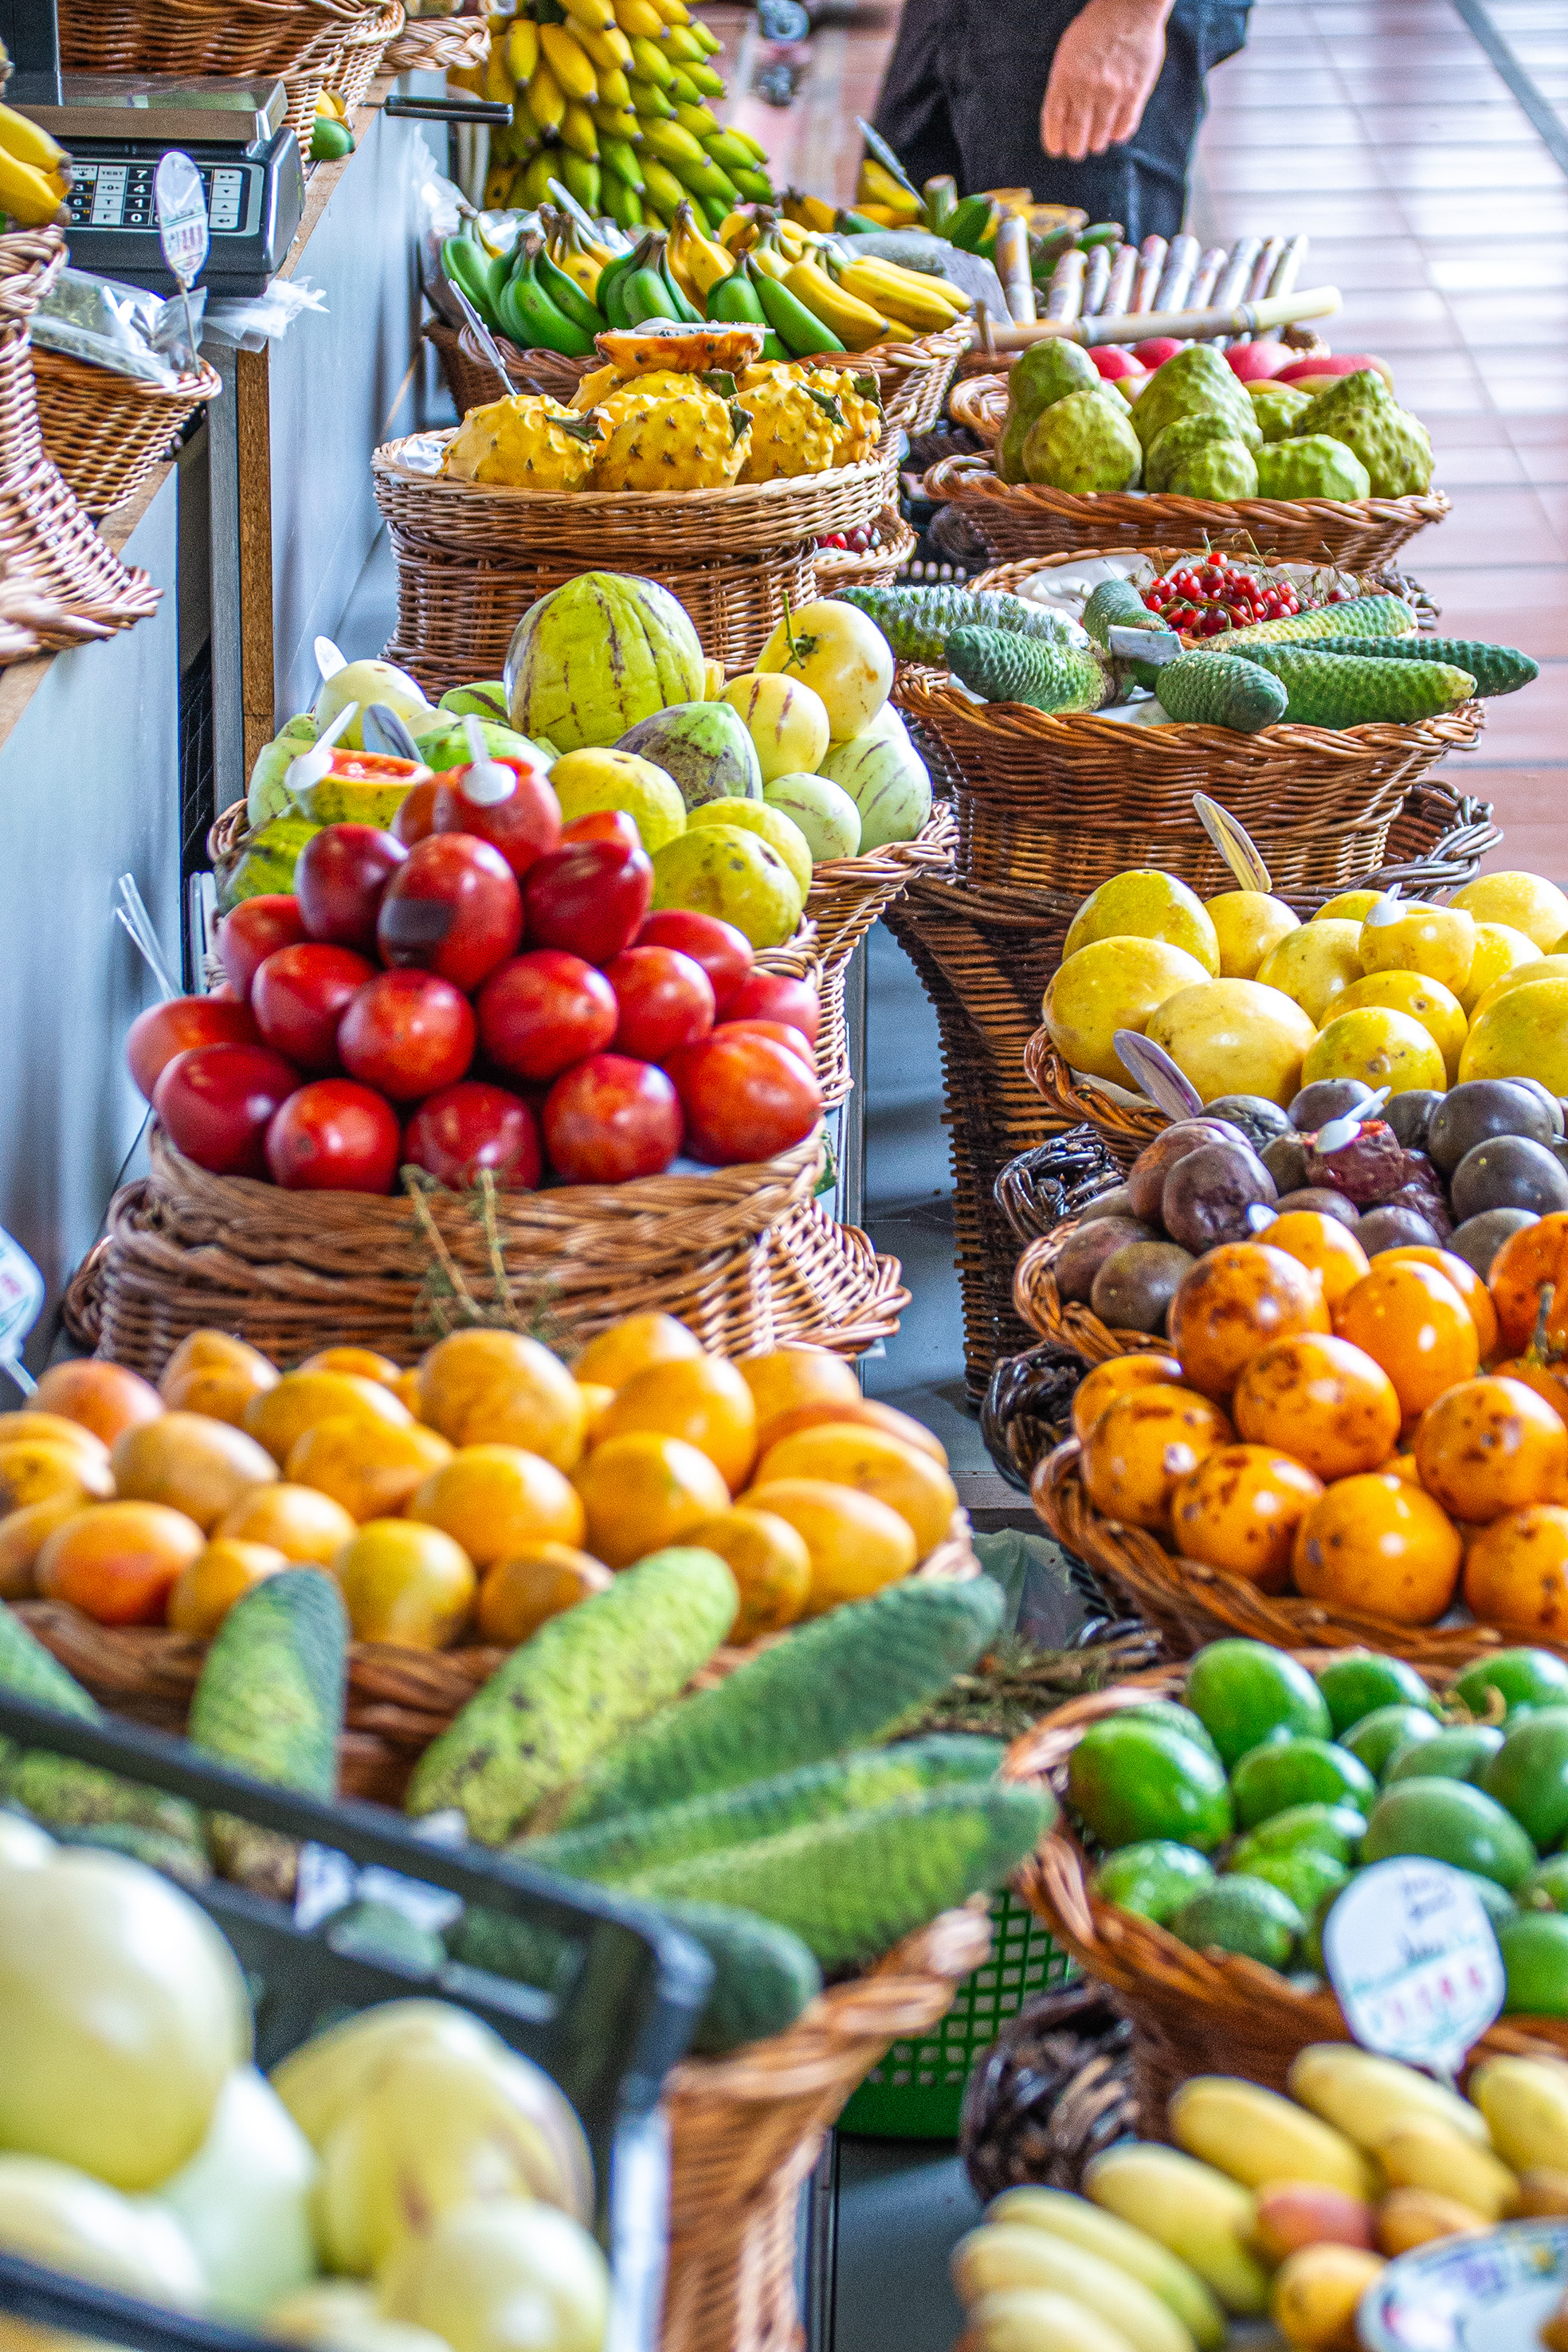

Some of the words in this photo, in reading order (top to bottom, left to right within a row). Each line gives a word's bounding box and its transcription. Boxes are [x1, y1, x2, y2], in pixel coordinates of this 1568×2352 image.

[136, 170, 147, 178] 7
[134, 184, 146, 194] 4
[135, 199, 143, 208] 1
[131, 214, 143, 222] 0
